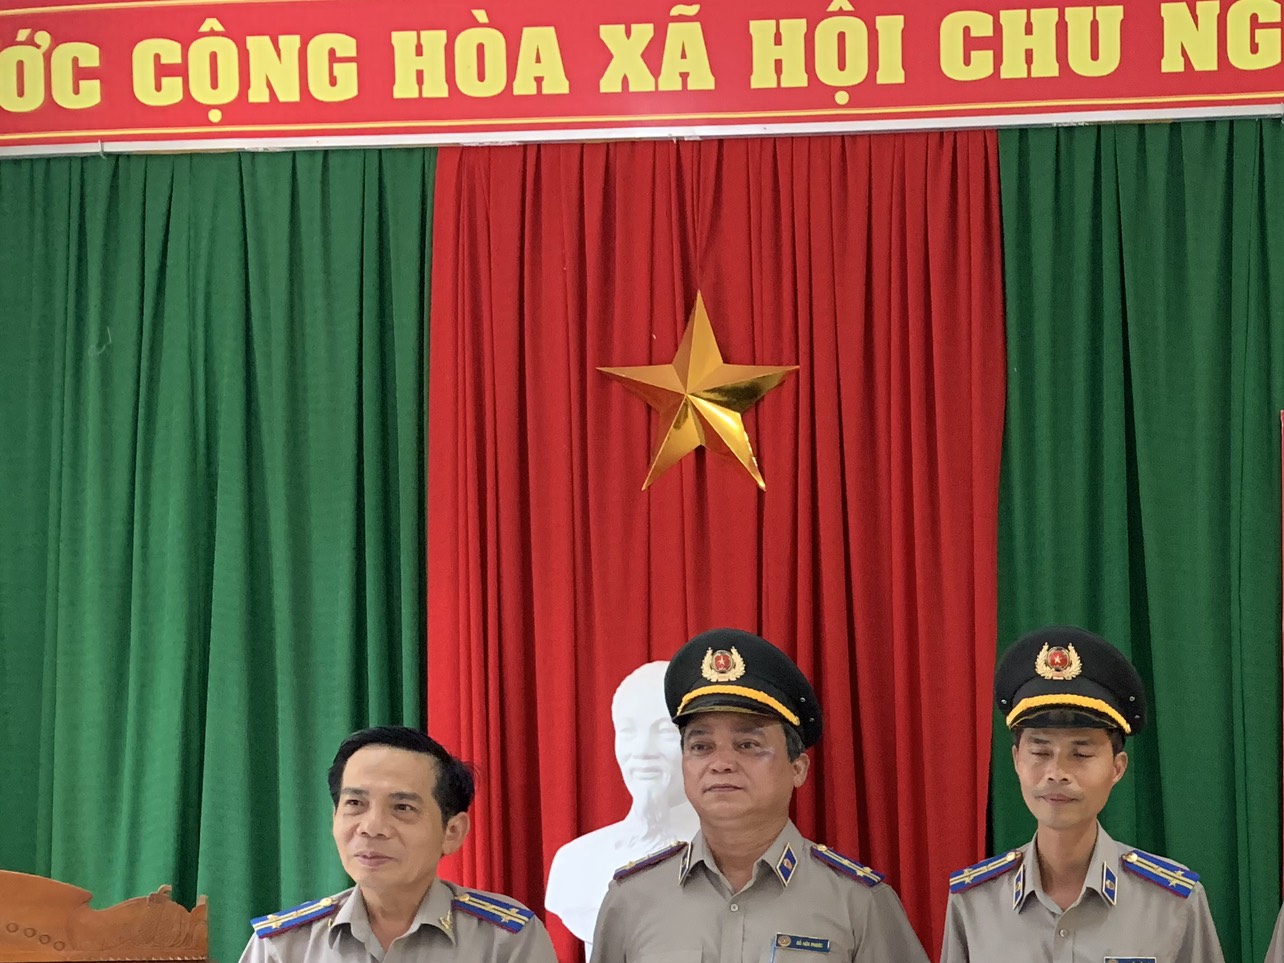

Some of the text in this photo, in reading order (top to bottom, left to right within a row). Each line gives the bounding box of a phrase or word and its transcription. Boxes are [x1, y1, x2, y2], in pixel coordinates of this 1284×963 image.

[132, 19, 359, 122] CỘNG
[391, 10, 570, 98] HÒA
[599, 4, 715, 93] XÃ
[749, 0, 905, 104] HỘI
